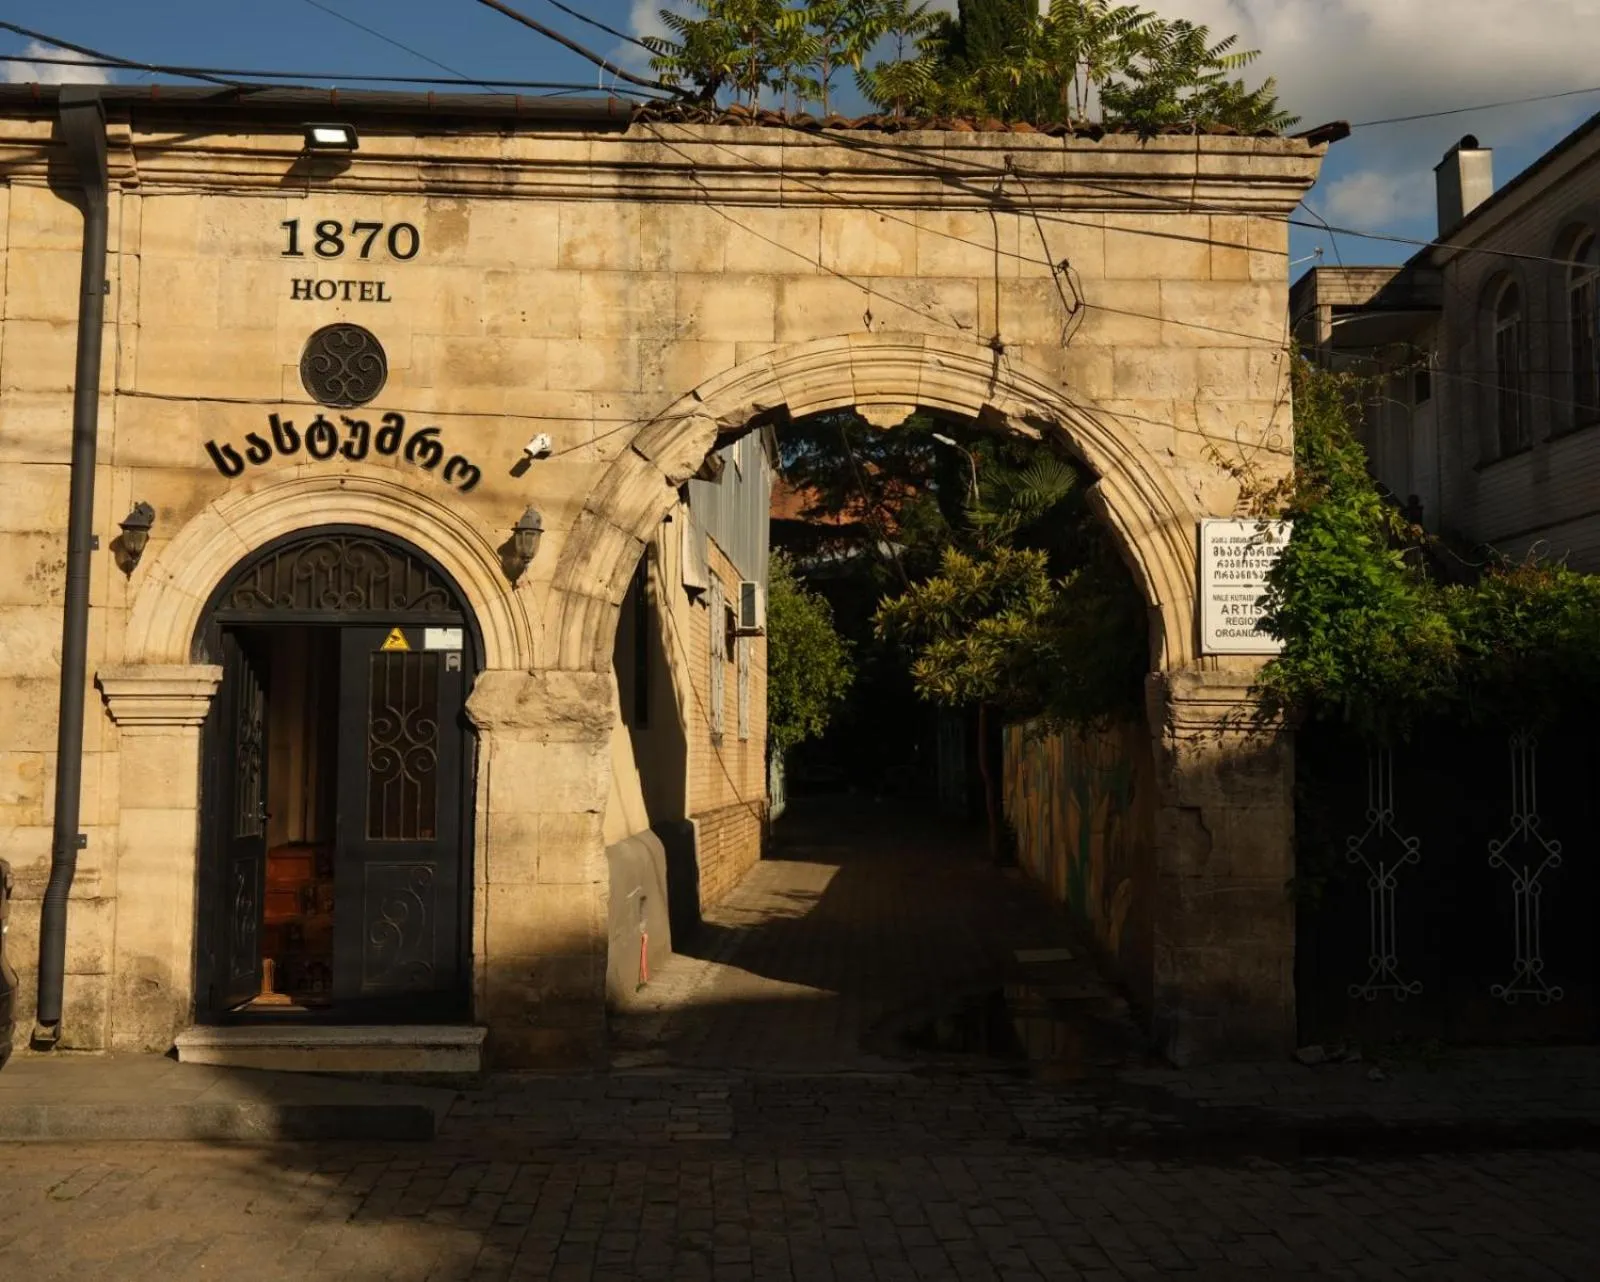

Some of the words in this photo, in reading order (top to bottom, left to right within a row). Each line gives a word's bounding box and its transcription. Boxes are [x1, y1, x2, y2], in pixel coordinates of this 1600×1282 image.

[281, 219, 420, 260] 1870
[290, 279, 392, 302] HOTEL
[203, 412, 481, 494] სასტუმრო
[1217, 559, 1271, 568] რეგიონულ
[1214, 570, 1265, 579] ორგანიზა
[1220, 604, 1263, 615] ARTIS
